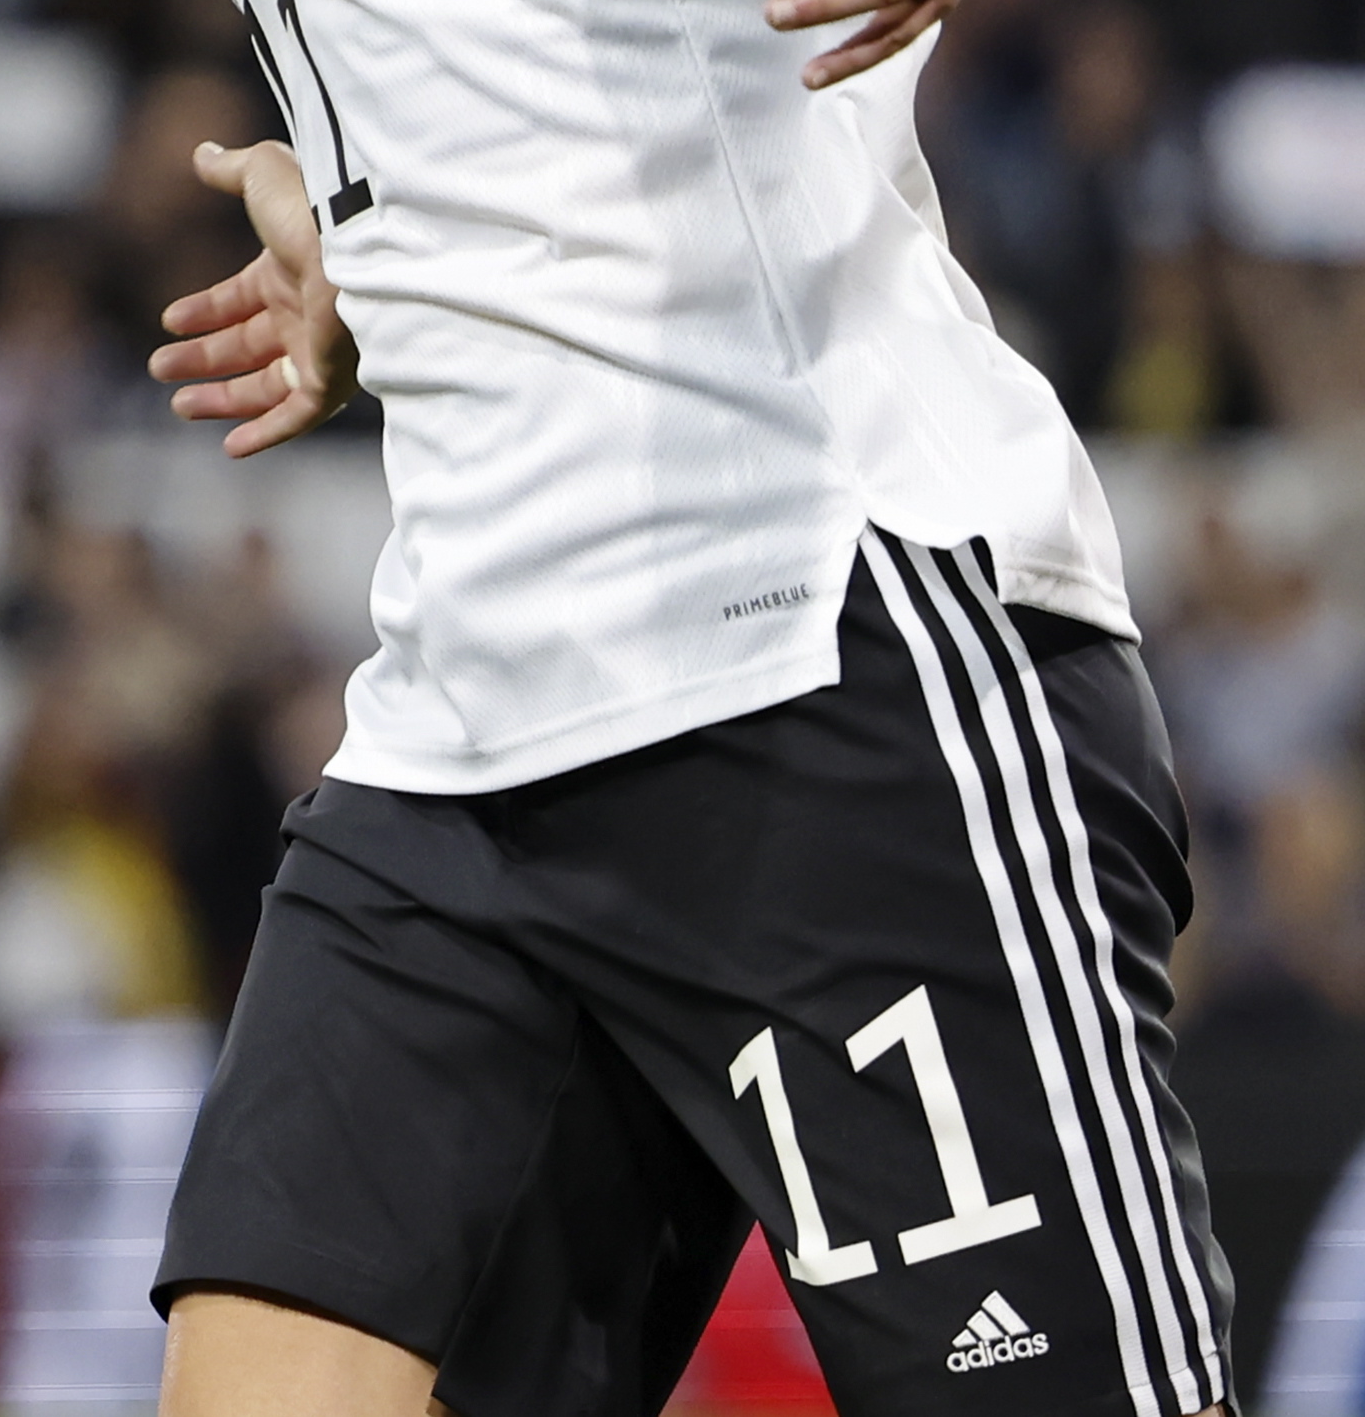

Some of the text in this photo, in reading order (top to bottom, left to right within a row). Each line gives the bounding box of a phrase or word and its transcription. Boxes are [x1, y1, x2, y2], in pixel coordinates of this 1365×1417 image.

[723, 583, 810, 621] PRIMEBLUE
[728, 983, 1042, 1288] 11
[946, 1332, 1050, 1373] adidas
